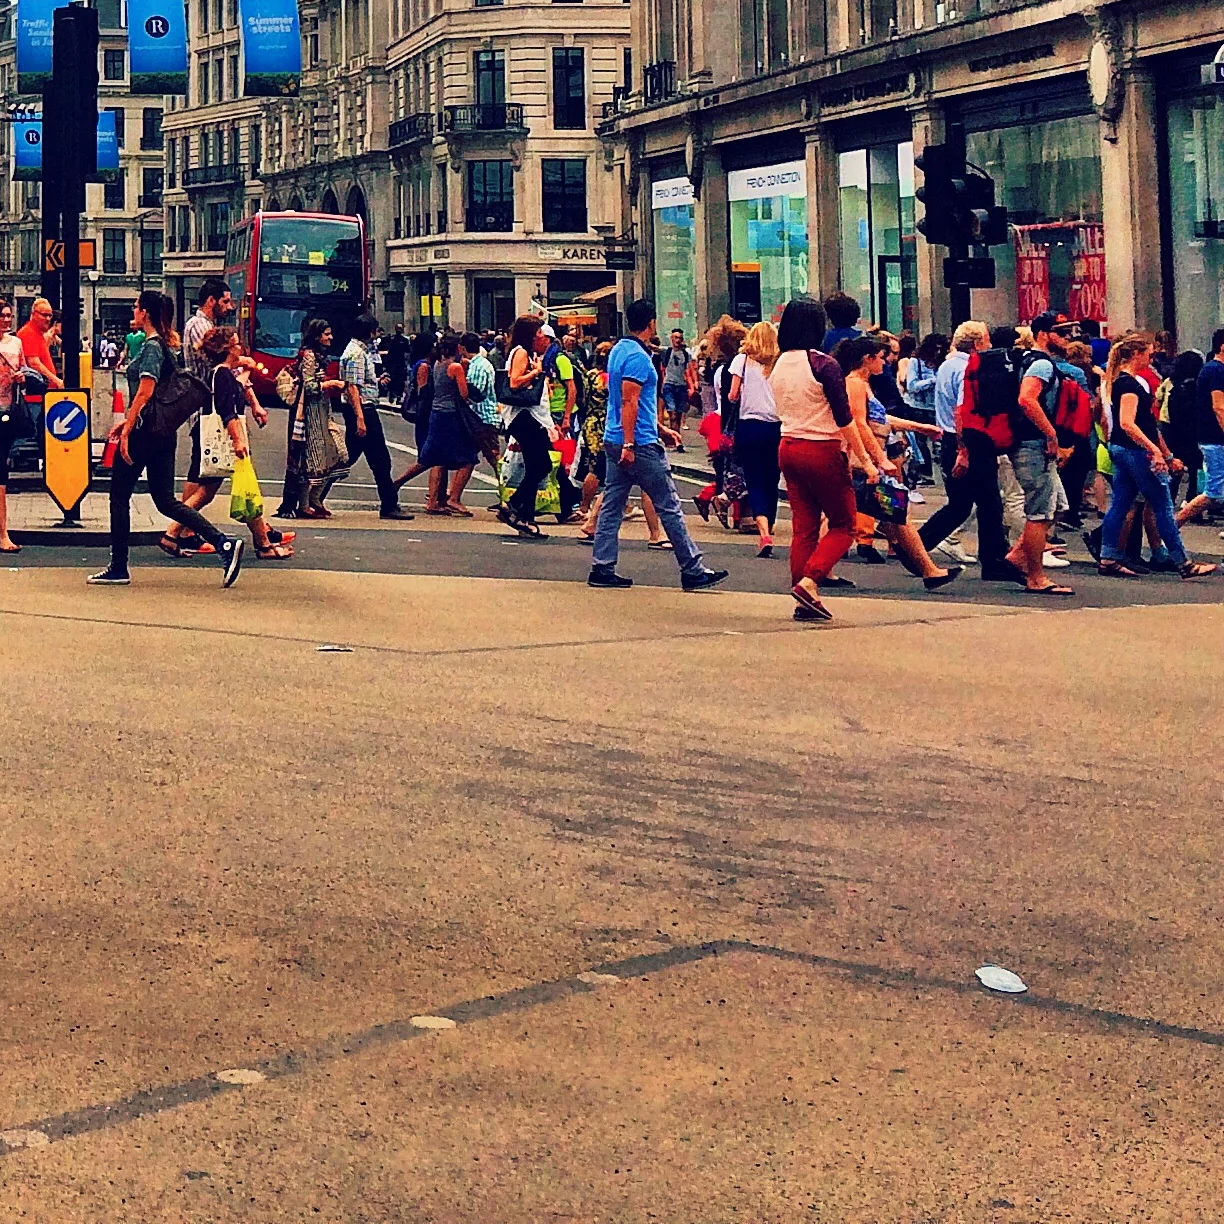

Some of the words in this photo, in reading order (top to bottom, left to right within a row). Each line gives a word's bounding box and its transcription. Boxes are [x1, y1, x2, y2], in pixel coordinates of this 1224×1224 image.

[151, 19, 165, 34] R
[248, 17, 294, 25] Summer
[251, 24, 291, 34] streets
[562, 248, 606, 260] KAREN
[332, 279, 349, 292] 94
